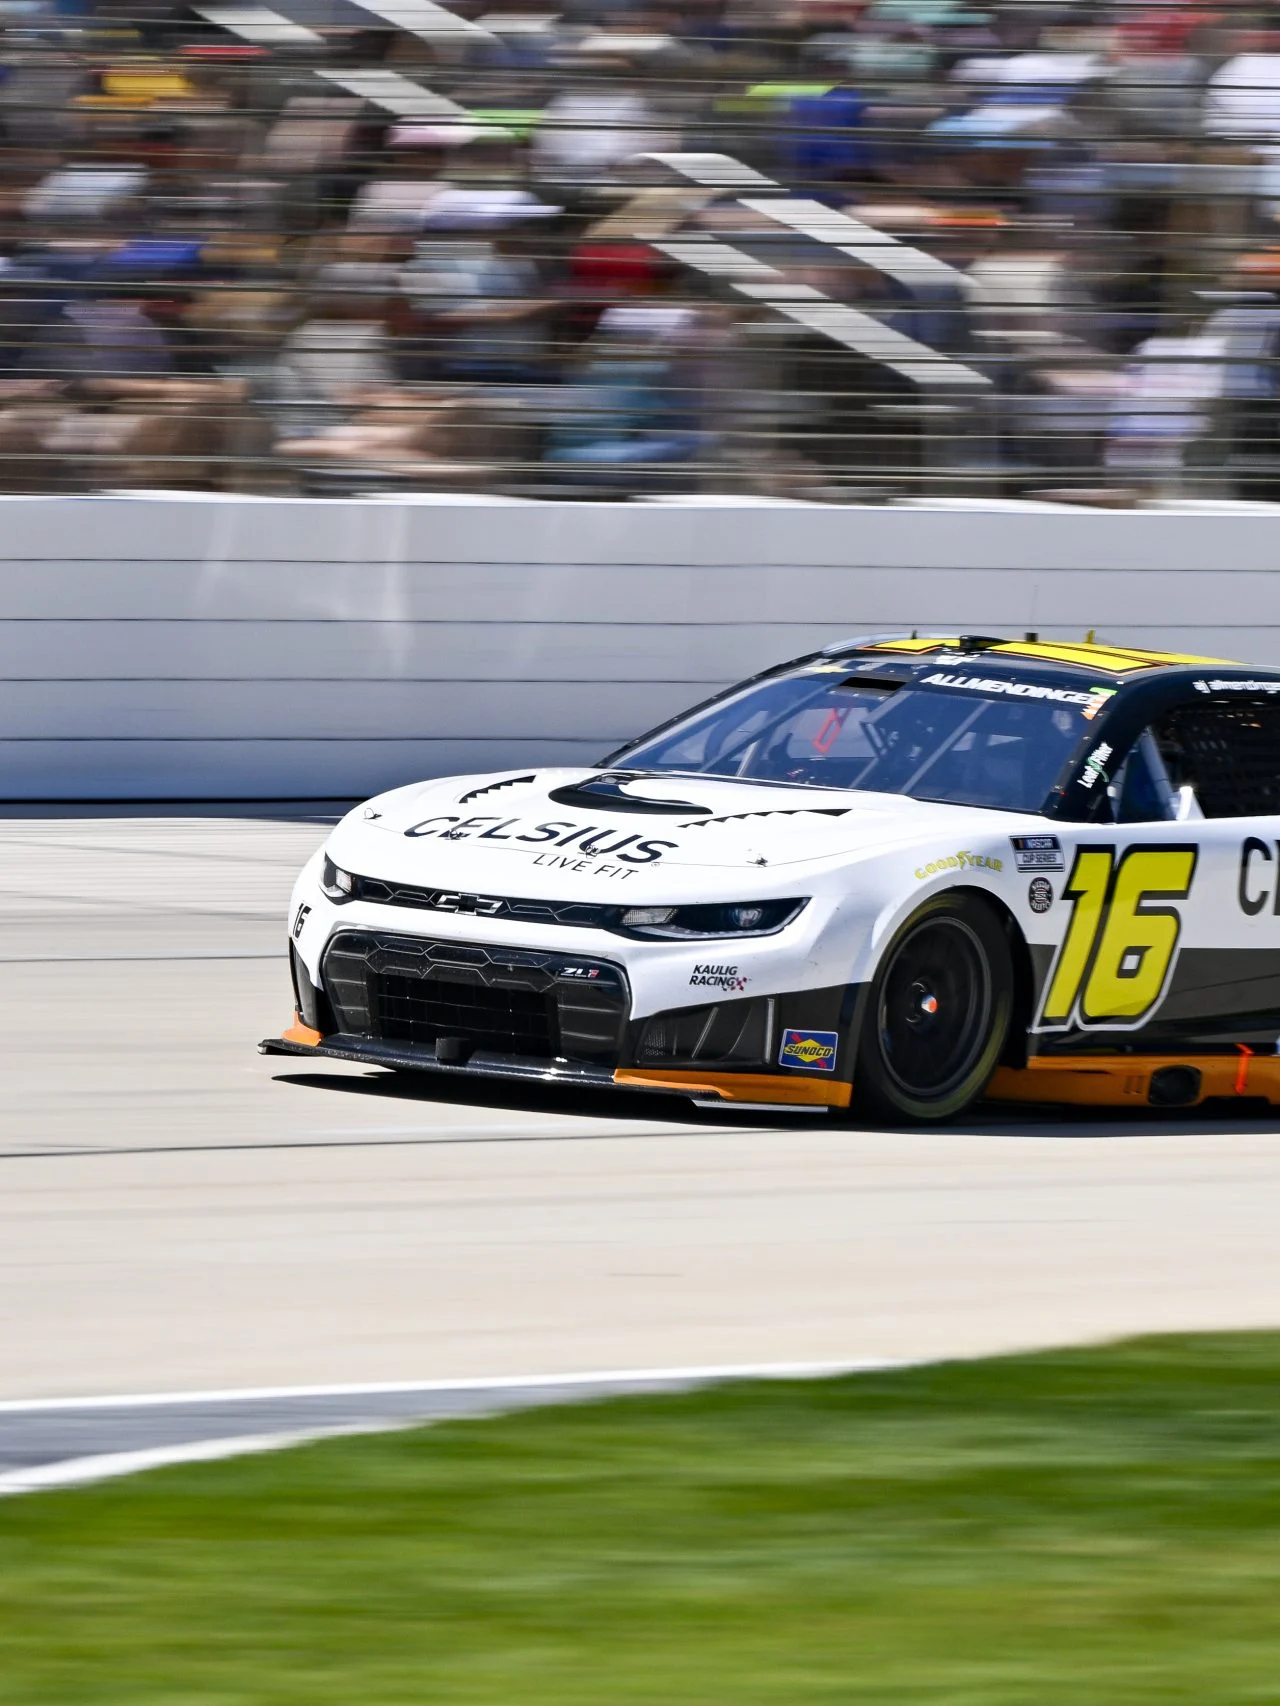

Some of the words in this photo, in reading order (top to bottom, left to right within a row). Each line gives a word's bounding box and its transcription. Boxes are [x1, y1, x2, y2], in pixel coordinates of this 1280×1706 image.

[404, 816, 679, 864] CELSIUS
[532, 853, 593, 872] LIVE
[594, 863, 640, 880] FIT
[914, 850, 1004, 881] GOODYEAR
[292, 902, 313, 939] 16
[1036, 843, 1199, 1031] 16
[689, 976, 736, 988] RACING
[692, 964, 739, 976] KAULIG
[784, 1044, 833, 1058] SUNOCO
